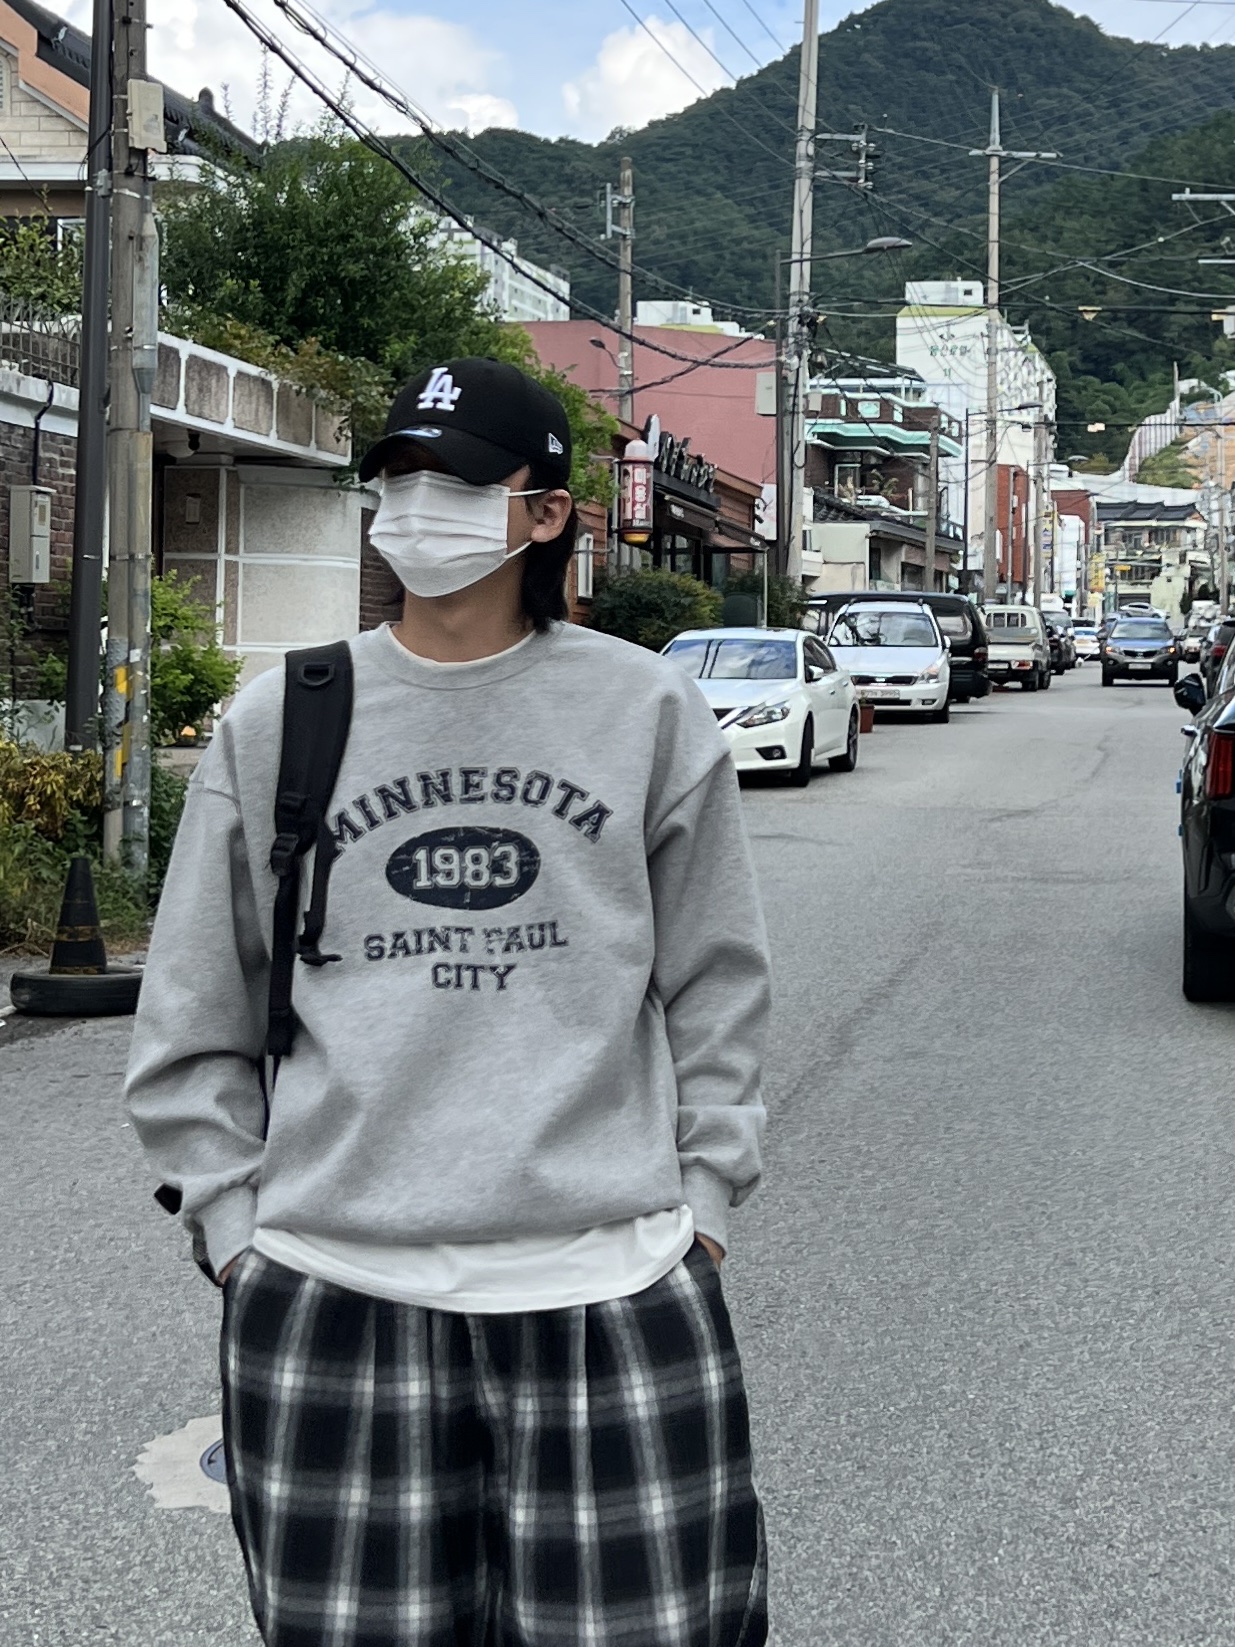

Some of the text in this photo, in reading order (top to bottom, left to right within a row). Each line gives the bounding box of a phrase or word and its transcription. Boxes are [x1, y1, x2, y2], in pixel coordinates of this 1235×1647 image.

[417, 367, 462, 411] LA
[333, 767, 614, 862] MINNESOTA
[412, 842, 521, 890] 1983
[364, 920, 569, 961] SAINT PAUL
[431, 961, 517, 991] CITY
